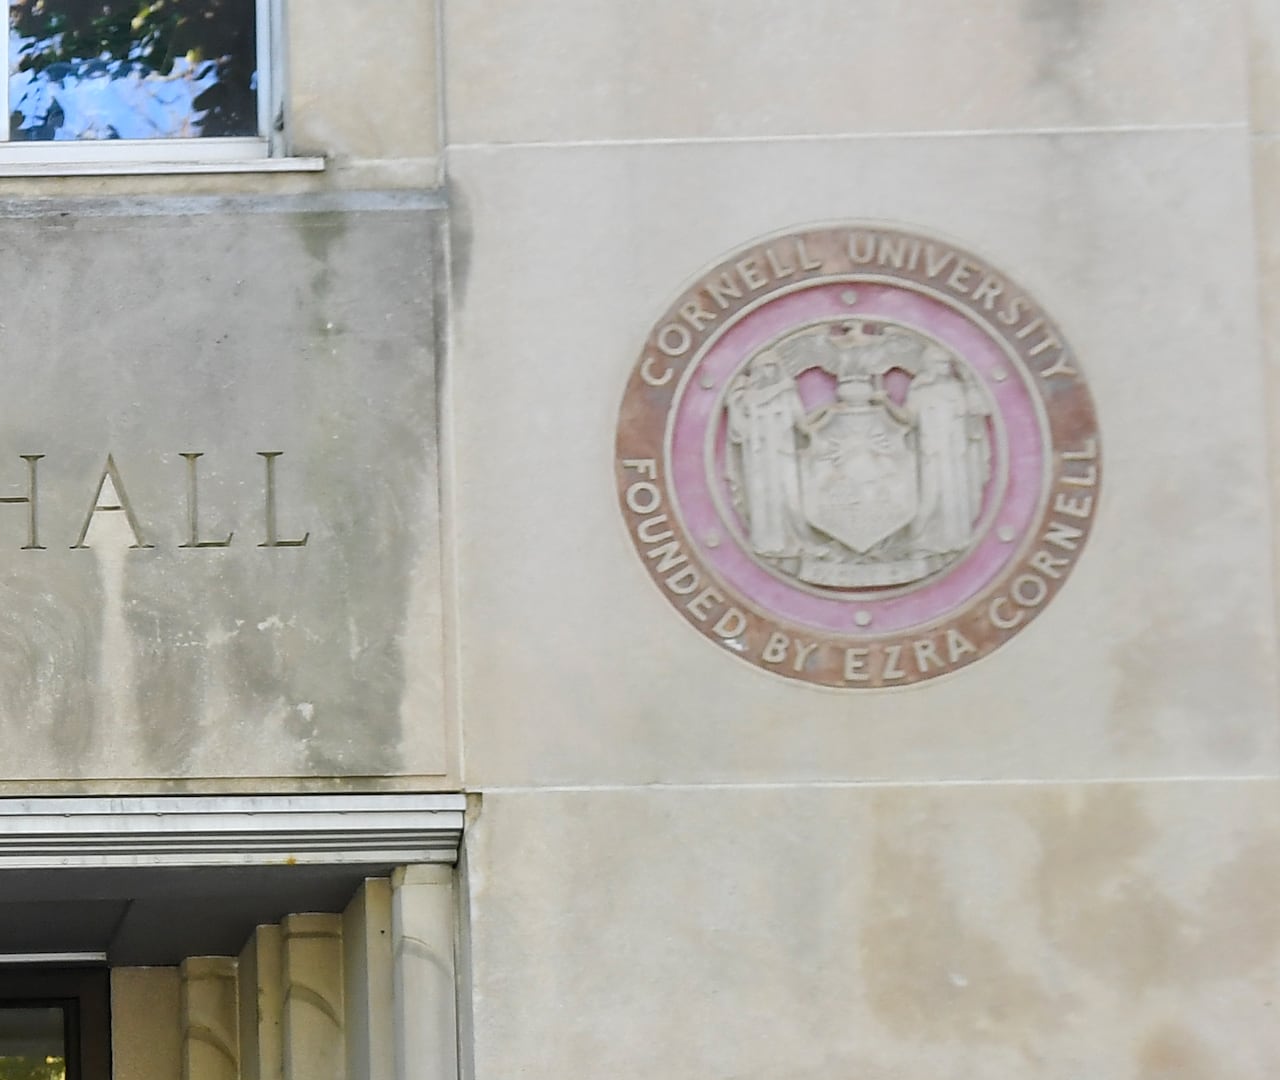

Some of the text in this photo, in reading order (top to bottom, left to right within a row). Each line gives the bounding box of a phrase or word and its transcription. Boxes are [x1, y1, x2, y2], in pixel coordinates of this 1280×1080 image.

[641, 234, 1078, 388] CORNELL UNIVERSITY
[623, 440, 1098, 681] FOUNDED BY EZRA CORNELL
